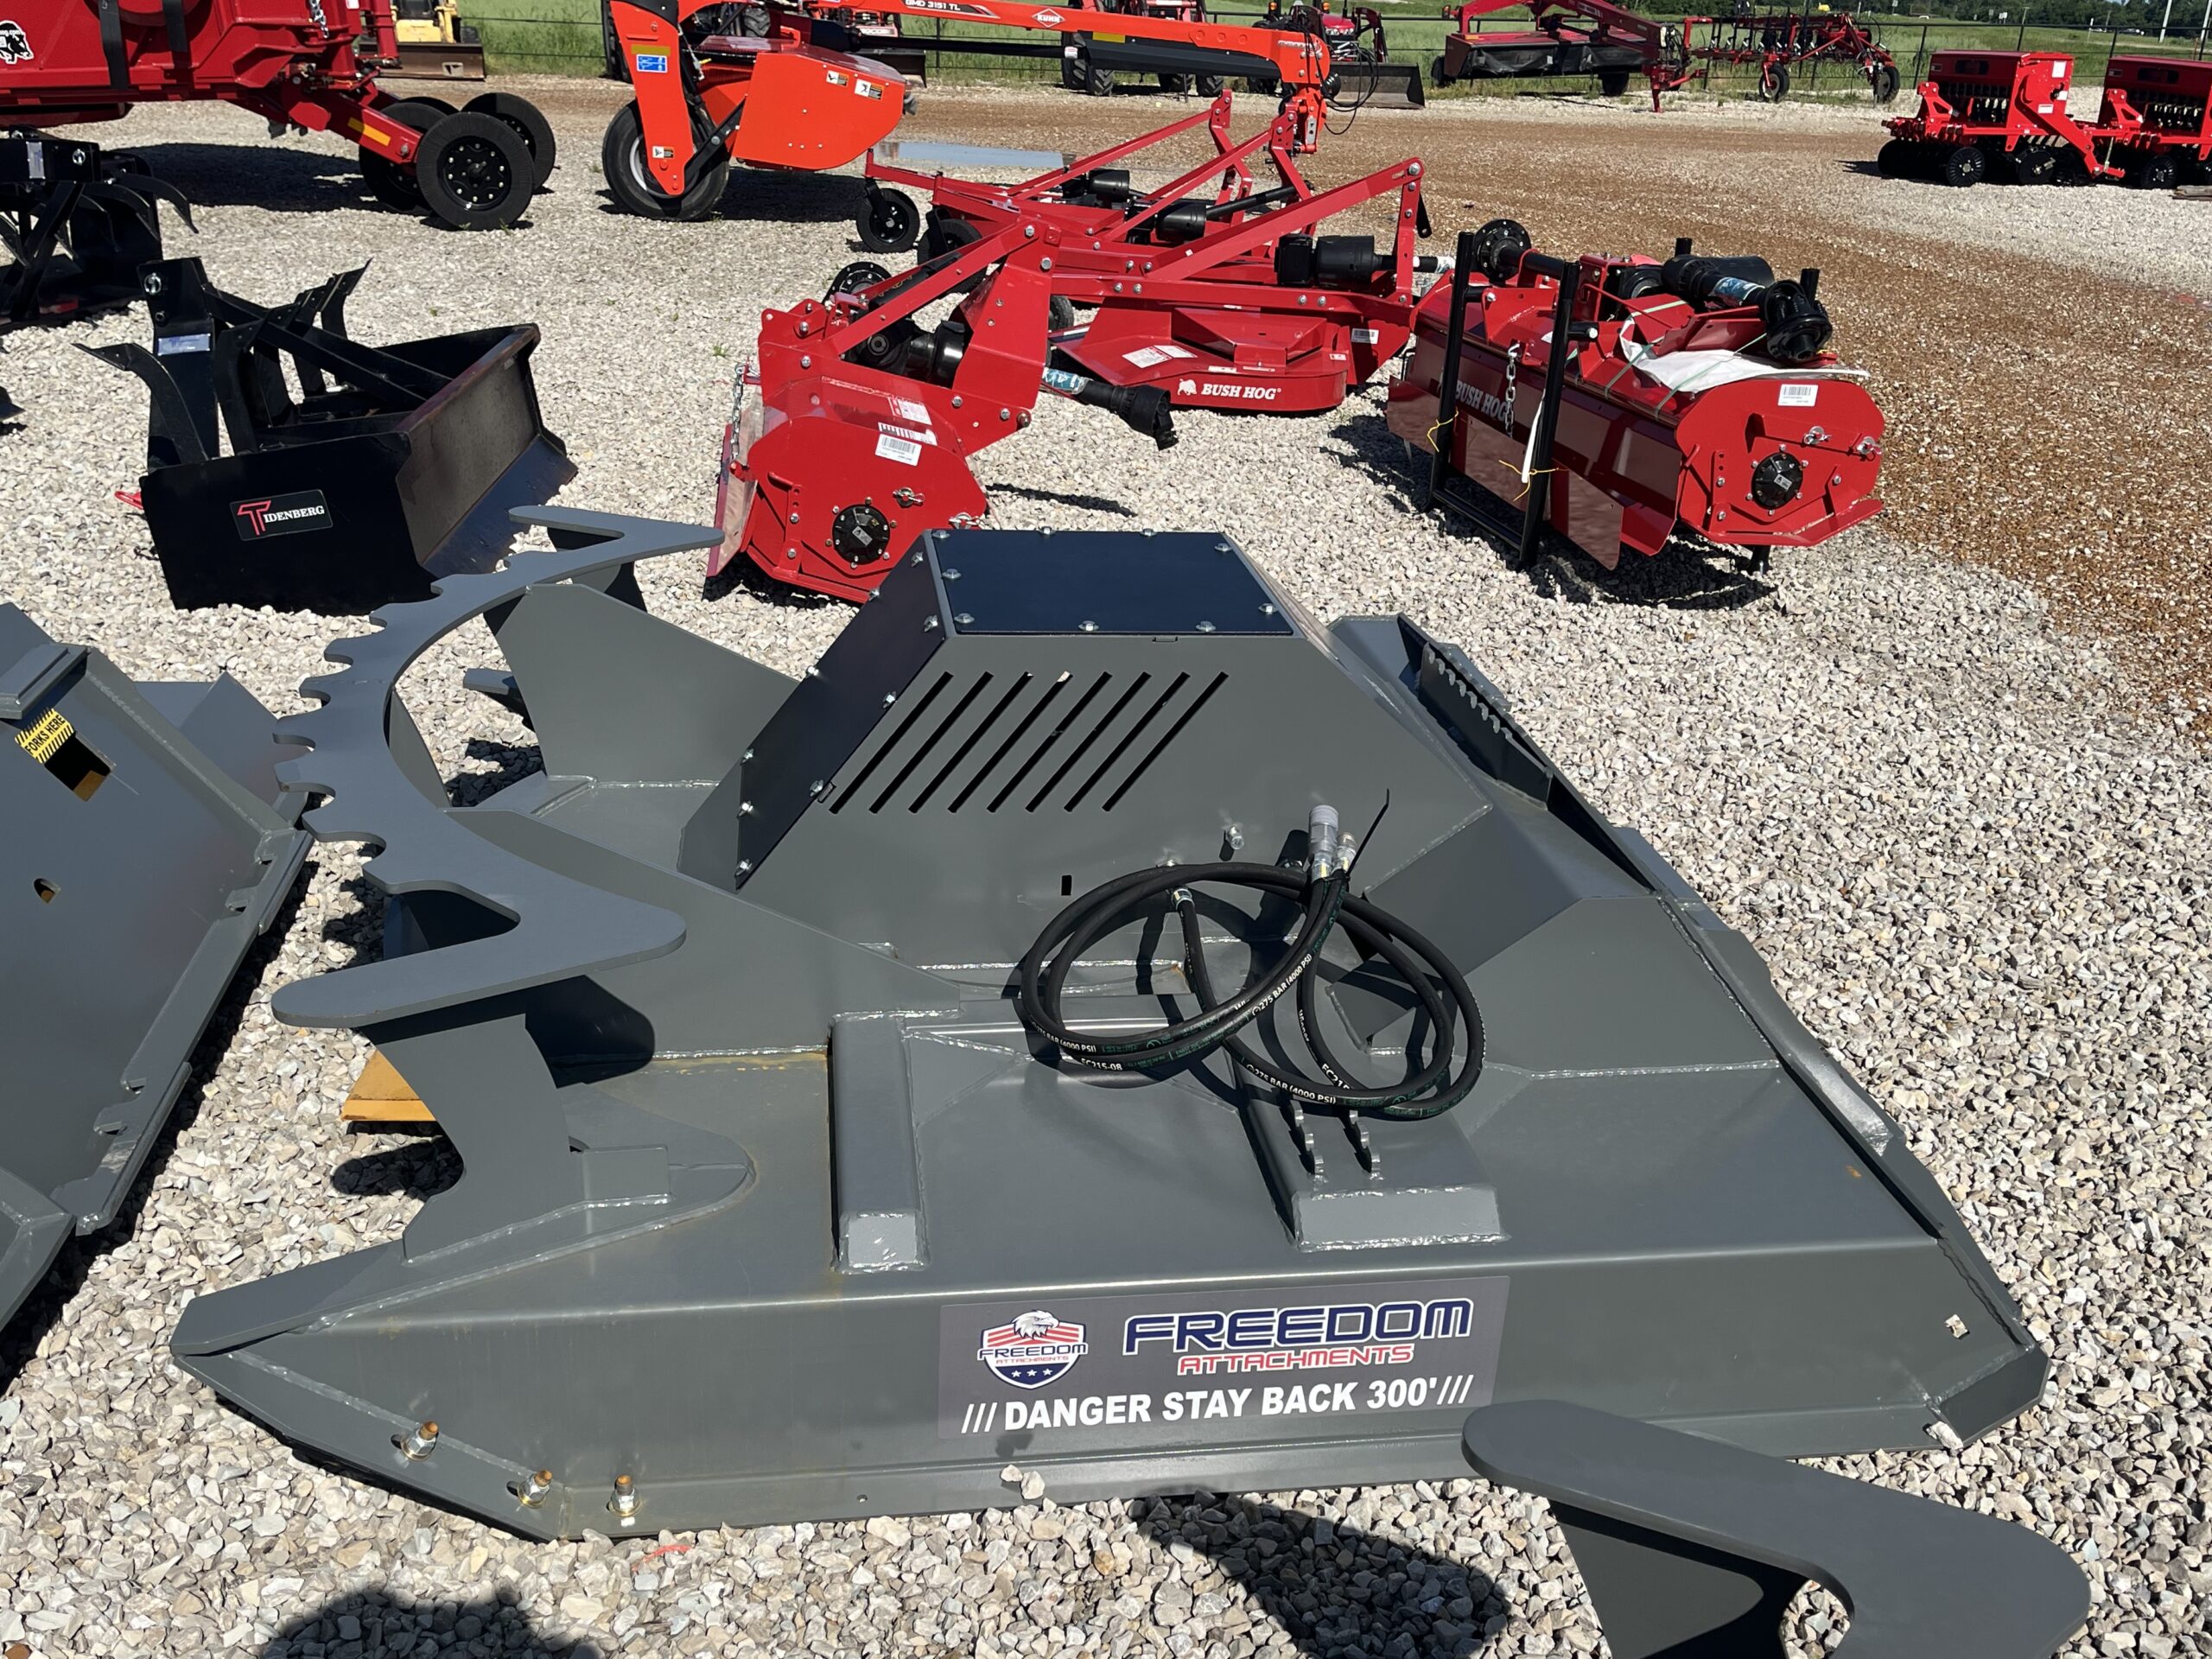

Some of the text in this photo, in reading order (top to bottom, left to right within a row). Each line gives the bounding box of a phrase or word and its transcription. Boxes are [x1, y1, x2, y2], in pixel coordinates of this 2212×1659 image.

[927, 1, 946, 10] 3151
[1037, 14, 1061, 22] KUHN
[1201, 383, 1242, 397] BUSH
[1455, 379, 1484, 410] BUSH
[237, 499, 325, 536] TIDENBERG
[25, 715, 66, 755] FORKS HERE
[1259, 953, 1313, 1010] 275 BAR (4000 PSI)
[1060, 1039, 1080, 1051] (4000
[1081, 1044, 1096, 1052] PSI)
[1270, 1077, 1288, 1090] BAR
[1289, 1085, 1315, 1099] (4000
[1318, 1094, 1337, 1104] PSI)
[1122, 1298, 1474, 1356] FREEDOM
[978, 1344, 1087, 1359] FREEDOM
[995, 1356, 1070, 1364] ATTACHMENTS
[1177, 1343, 1415, 1376] ATTACHMENTS
[1005, 1394, 1151, 1430] DANGER
[1162, 1388, 1252, 1421] STAY
[1261, 1382, 1358, 1416] BACK
